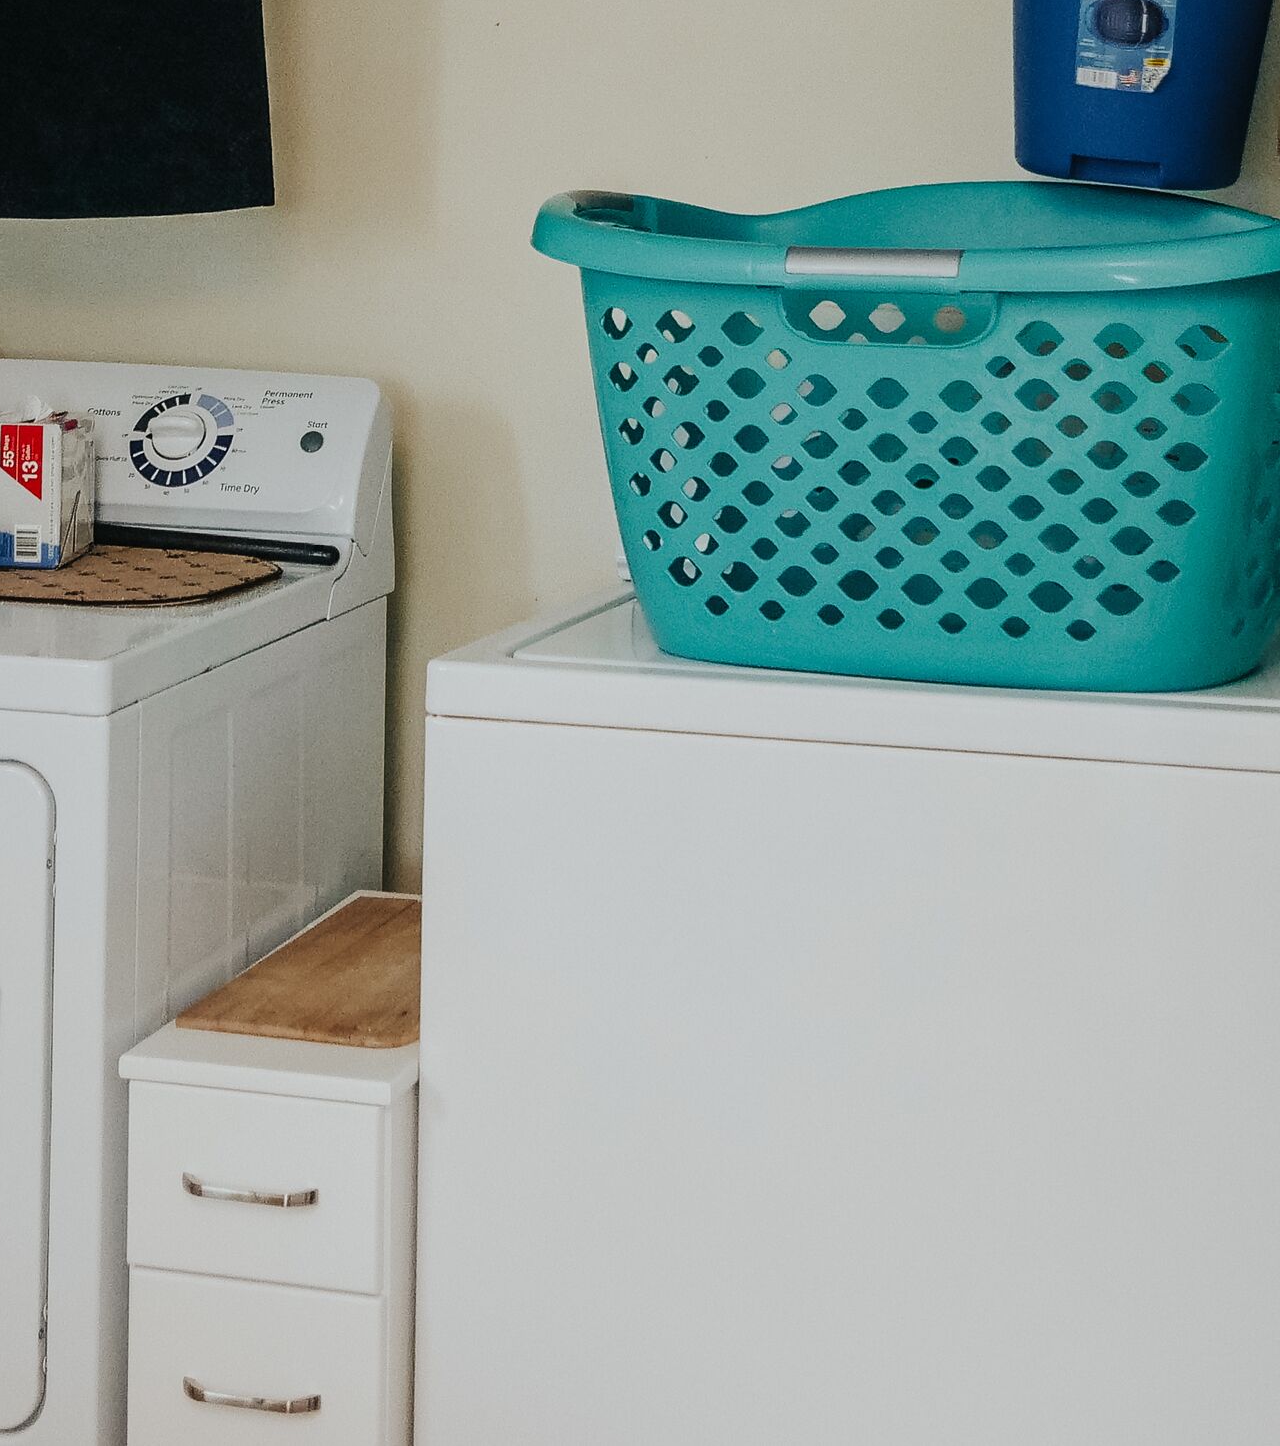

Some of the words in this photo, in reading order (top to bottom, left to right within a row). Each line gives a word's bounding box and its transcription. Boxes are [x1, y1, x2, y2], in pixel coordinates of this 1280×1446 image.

[264, 389, 314, 400] Permanent
[261, 397, 286, 406] Press
[86, 407, 121, 417] Cottons
[306, 420, 329, 429] Start
[3, 450, 15, 468] 55
[21, 460, 39, 483] 13
[220, 483, 242, 493] Time
[243, 483, 261, 496] Dry
